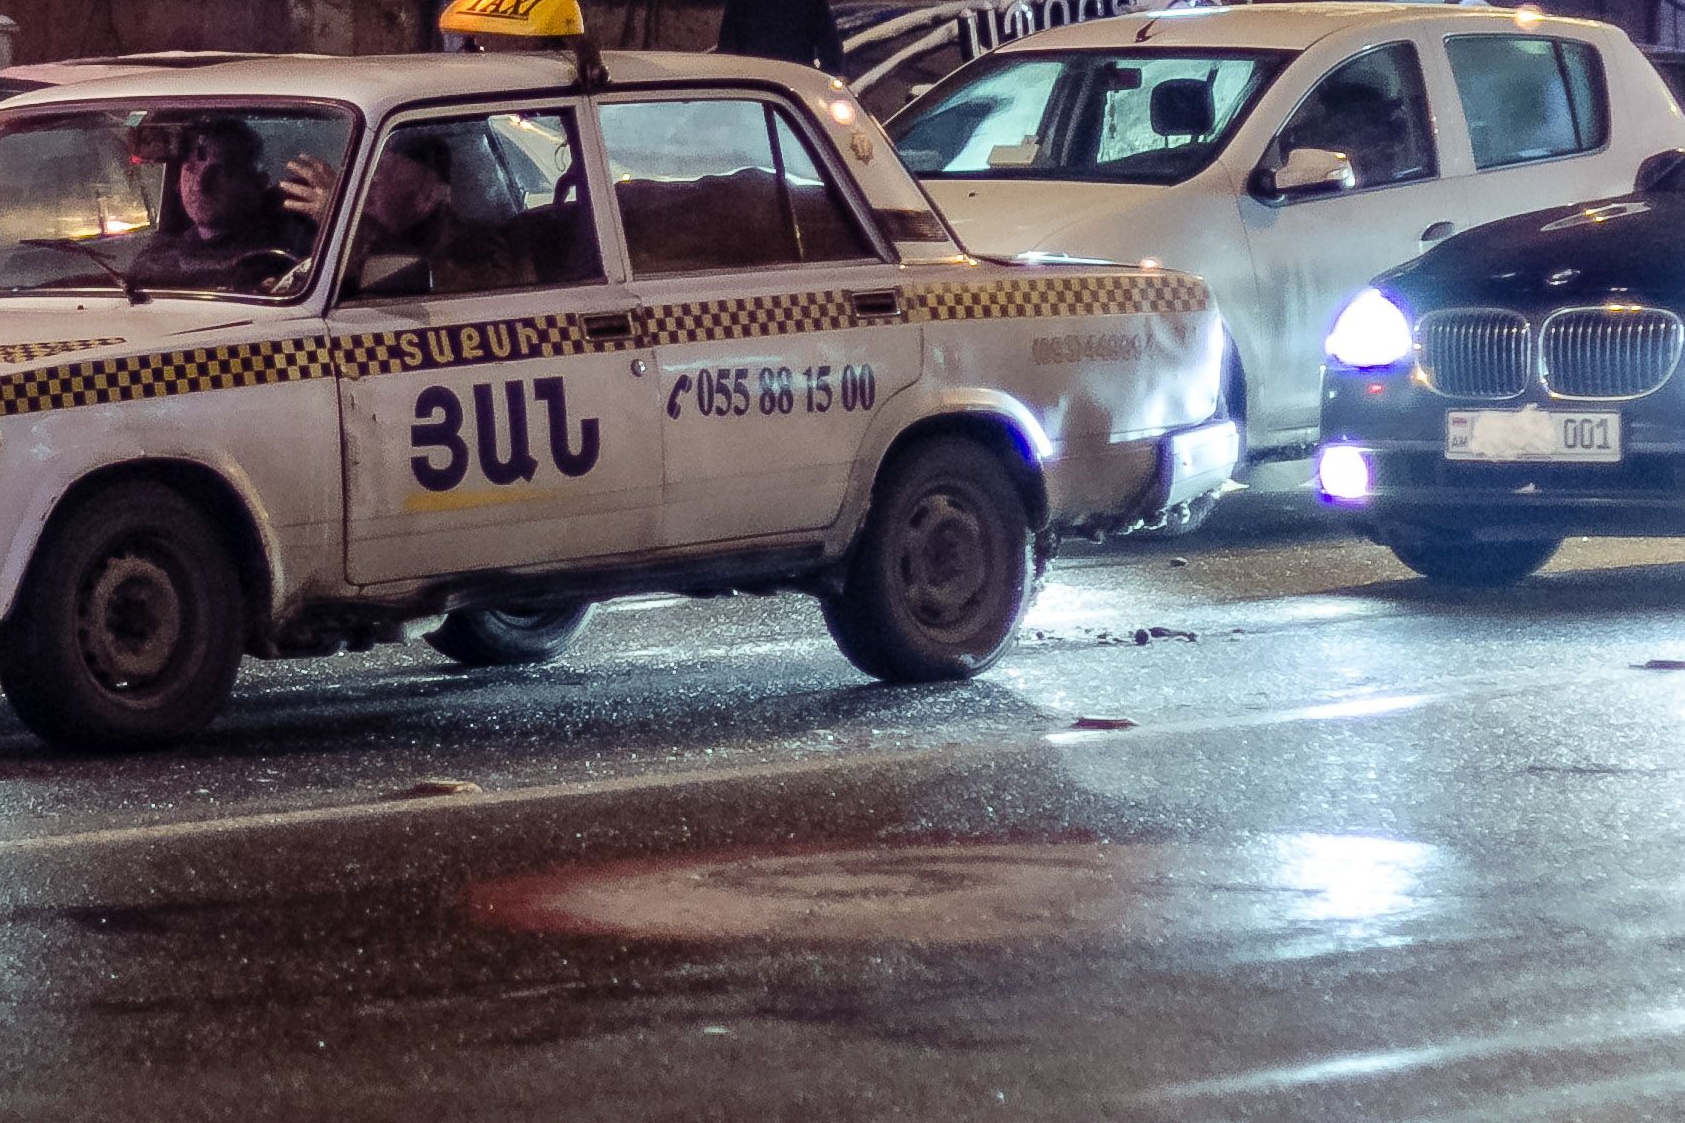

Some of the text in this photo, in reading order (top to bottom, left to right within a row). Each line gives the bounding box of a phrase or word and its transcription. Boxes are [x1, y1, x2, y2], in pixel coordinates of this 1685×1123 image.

[399, 322, 540, 367] ՏԱՔՍԻ
[697, 363, 876, 417] 055 88 15 00
[410, 376, 601, 492] ՅԱՆ
[1565, 418, 1611, 449] 001
